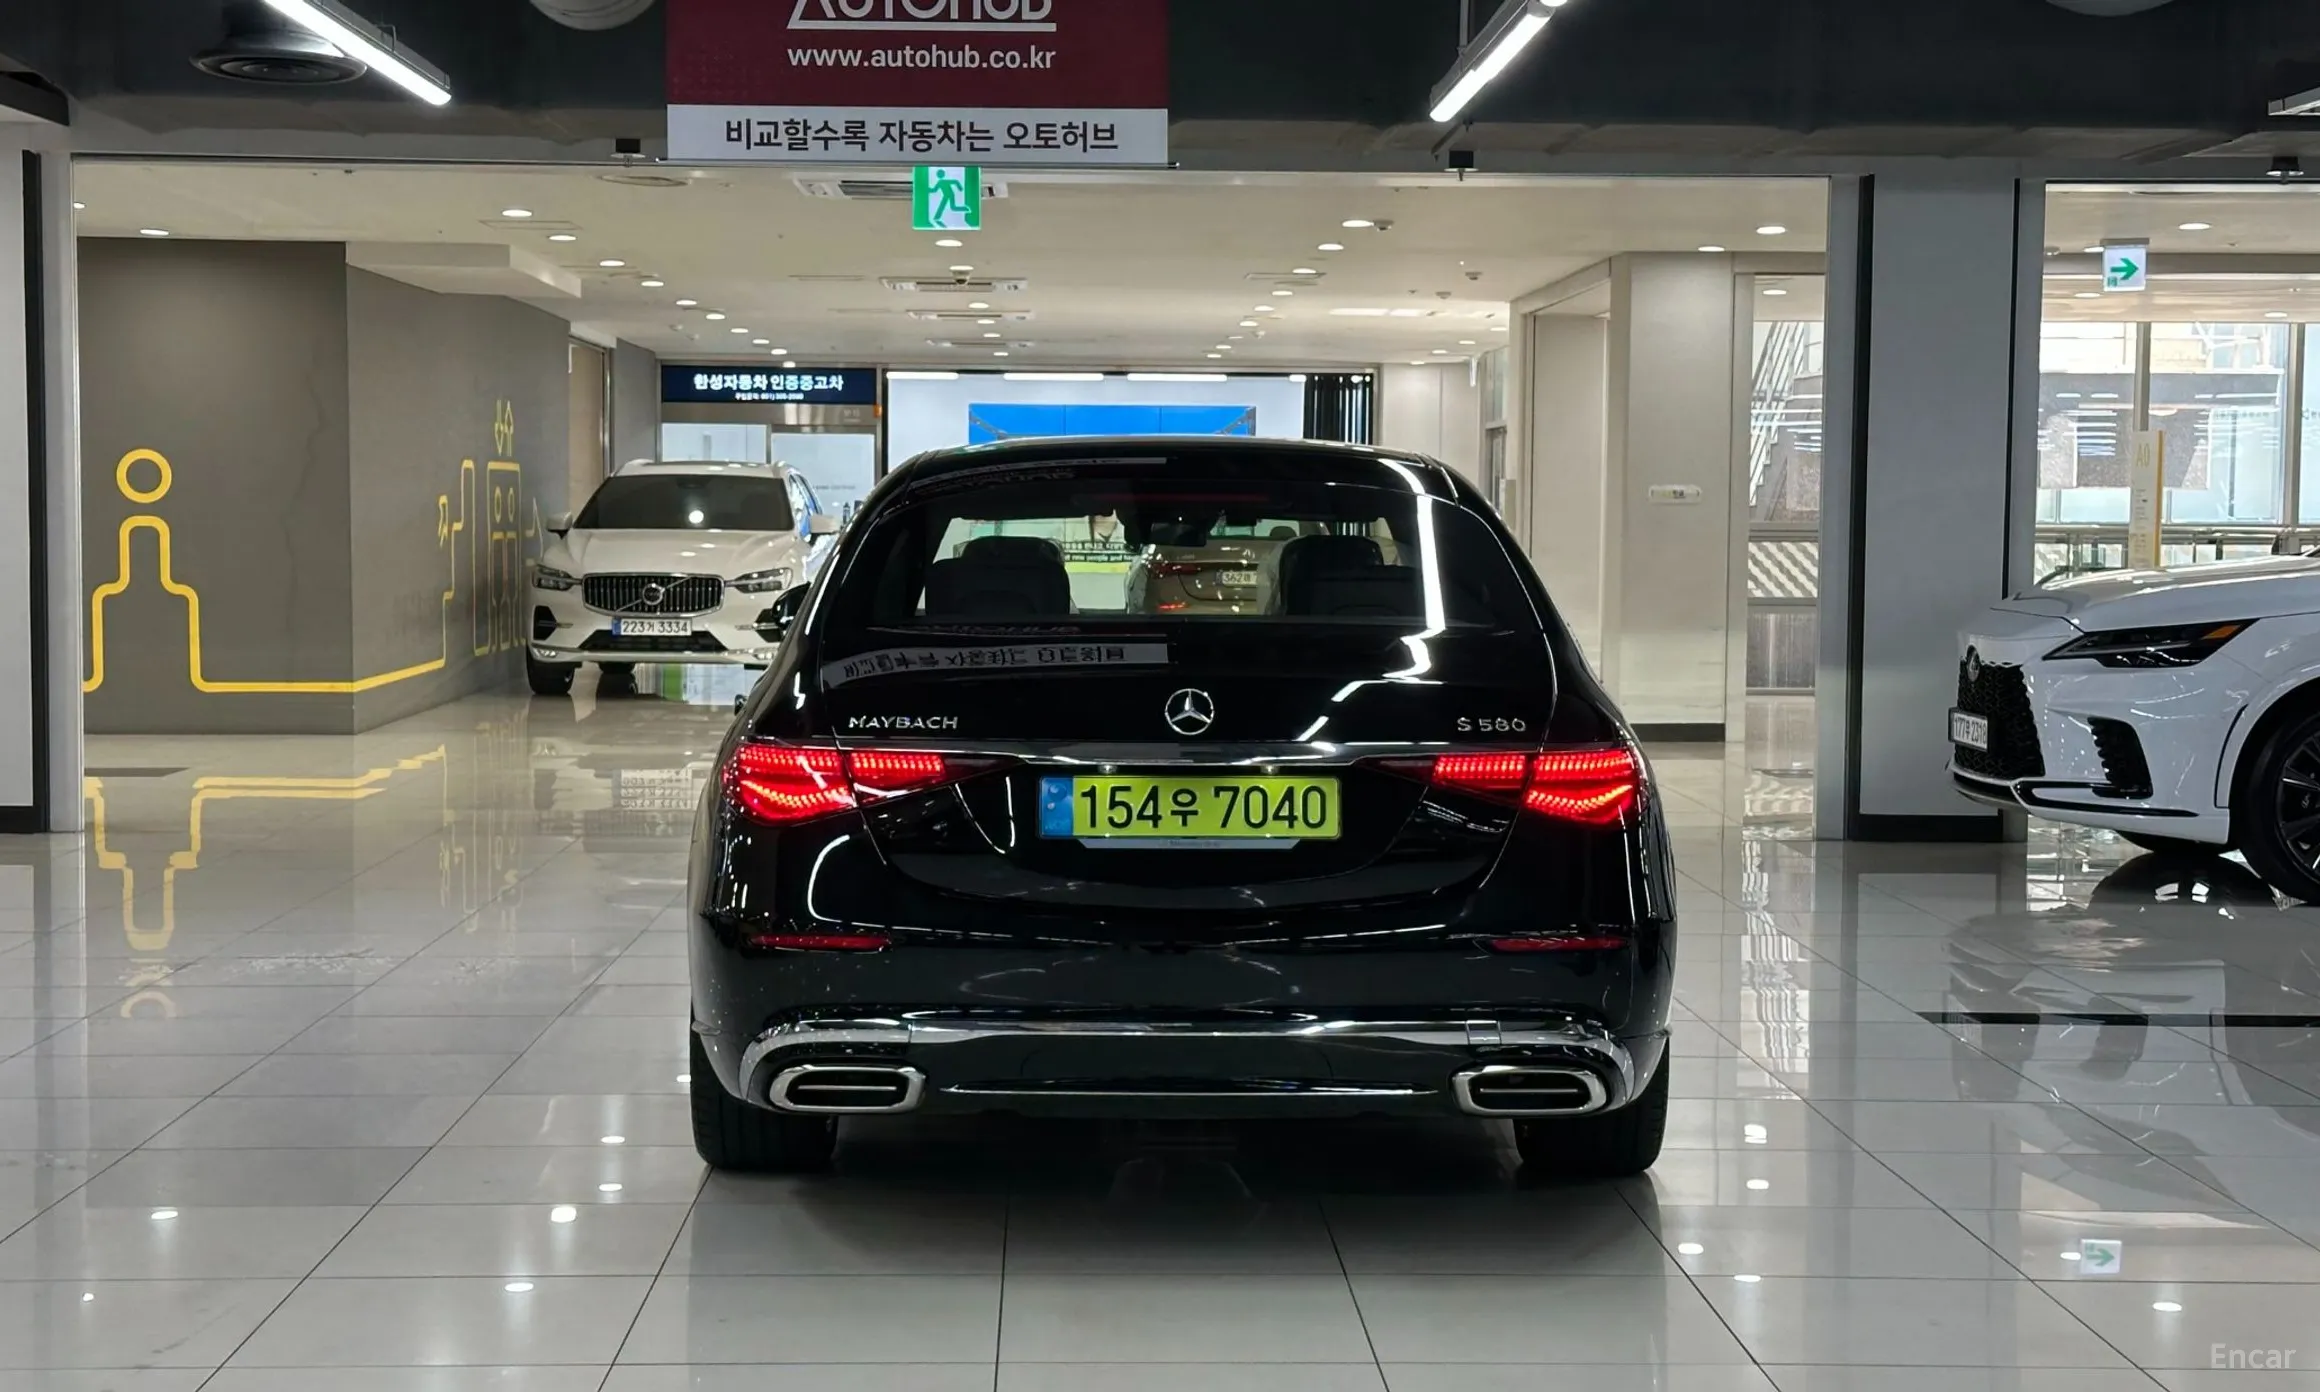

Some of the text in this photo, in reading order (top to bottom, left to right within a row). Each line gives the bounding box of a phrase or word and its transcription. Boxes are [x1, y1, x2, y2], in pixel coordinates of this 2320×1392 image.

[787, 44, 1057, 69] www.autohub.co.kr
[725, 118, 1119, 152] 비교할수록 자동차는 오토허브
[693, 373, 844, 391] 한성자동차 인증중고차
[659, 620, 688, 634] 3334
[848, 715, 959, 730] MAYBACH
[1456, 716, 1526, 732] S 580
[1080, 784, 1327, 829] 154우 7040
